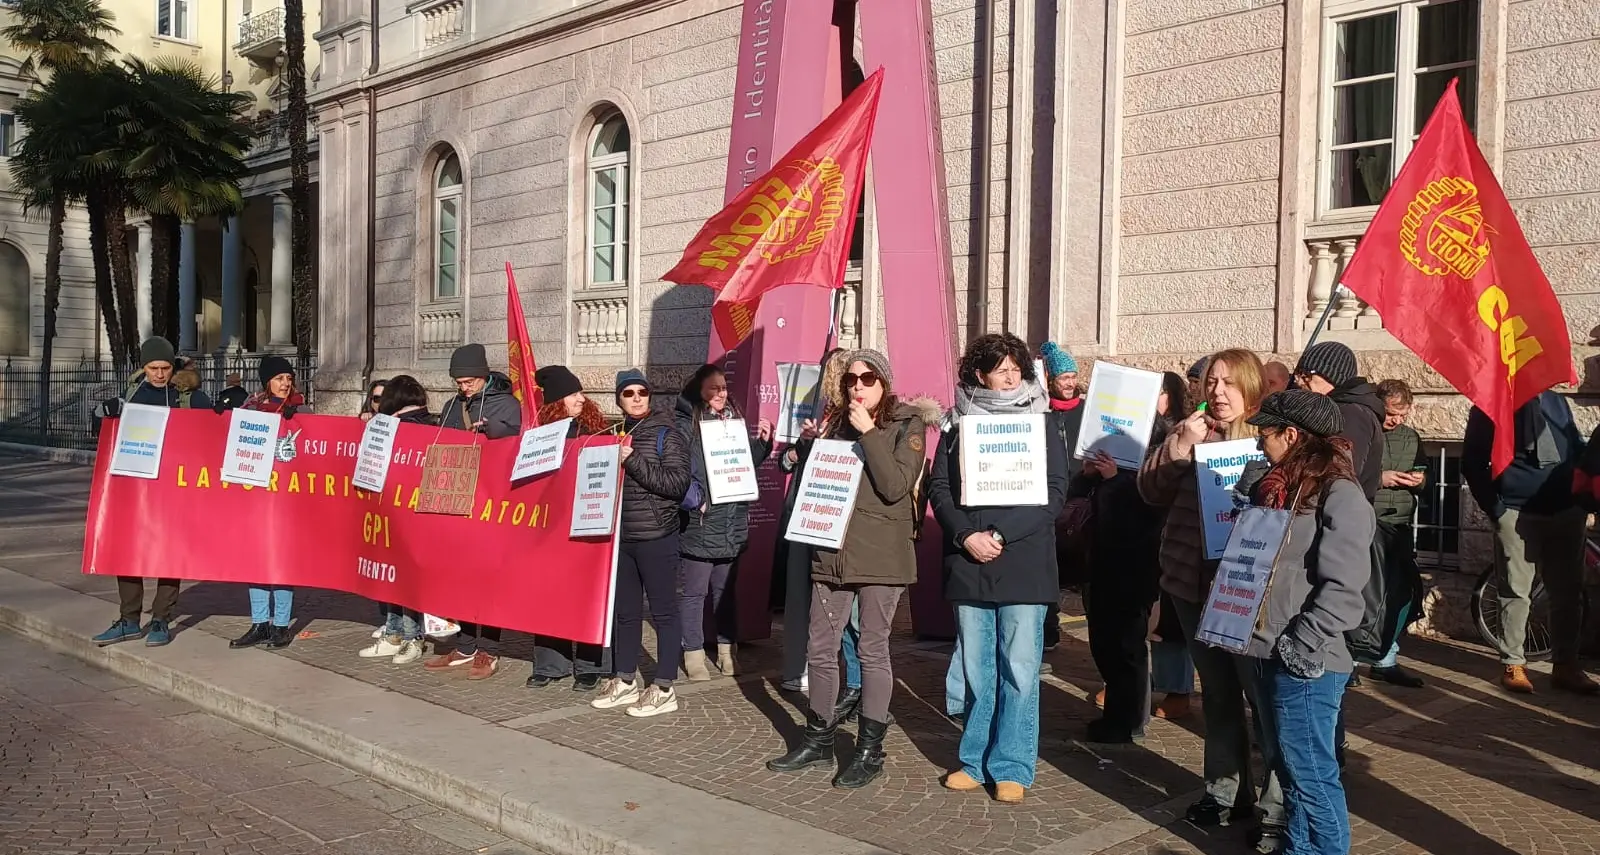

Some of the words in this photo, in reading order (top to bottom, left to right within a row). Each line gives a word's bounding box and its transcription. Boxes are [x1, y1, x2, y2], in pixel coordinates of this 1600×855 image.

[1432, 231, 1478, 276] FIOM
[240, 420, 270, 433] Clausole
[976, 421, 1032, 434] Autonomia
[238, 435, 266, 446] sociali?
[236, 448, 251, 458] Solo
[252, 451, 264, 460] per
[304, 439, 327, 455] RSU
[336, 441, 361, 457] FIO
[394, 447, 411, 466] del
[820, 453, 837, 464] cosa
[838, 454, 858, 466] serve
[427, 470, 456, 491] NON
[457, 472, 471, 492] SI
[811, 467, 852, 482] l'Autonomia
[1214, 475, 1221, 486] è
[830, 485, 849, 493] Provincia
[800, 502, 814, 513] per
[813, 503, 844, 517] toglierci
[363, 511, 390, 548] GPI
[806, 518, 833, 532] lavoro?
[1240, 538, 1261, 550] Provincia
[358, 556, 396, 583] TRENTO
